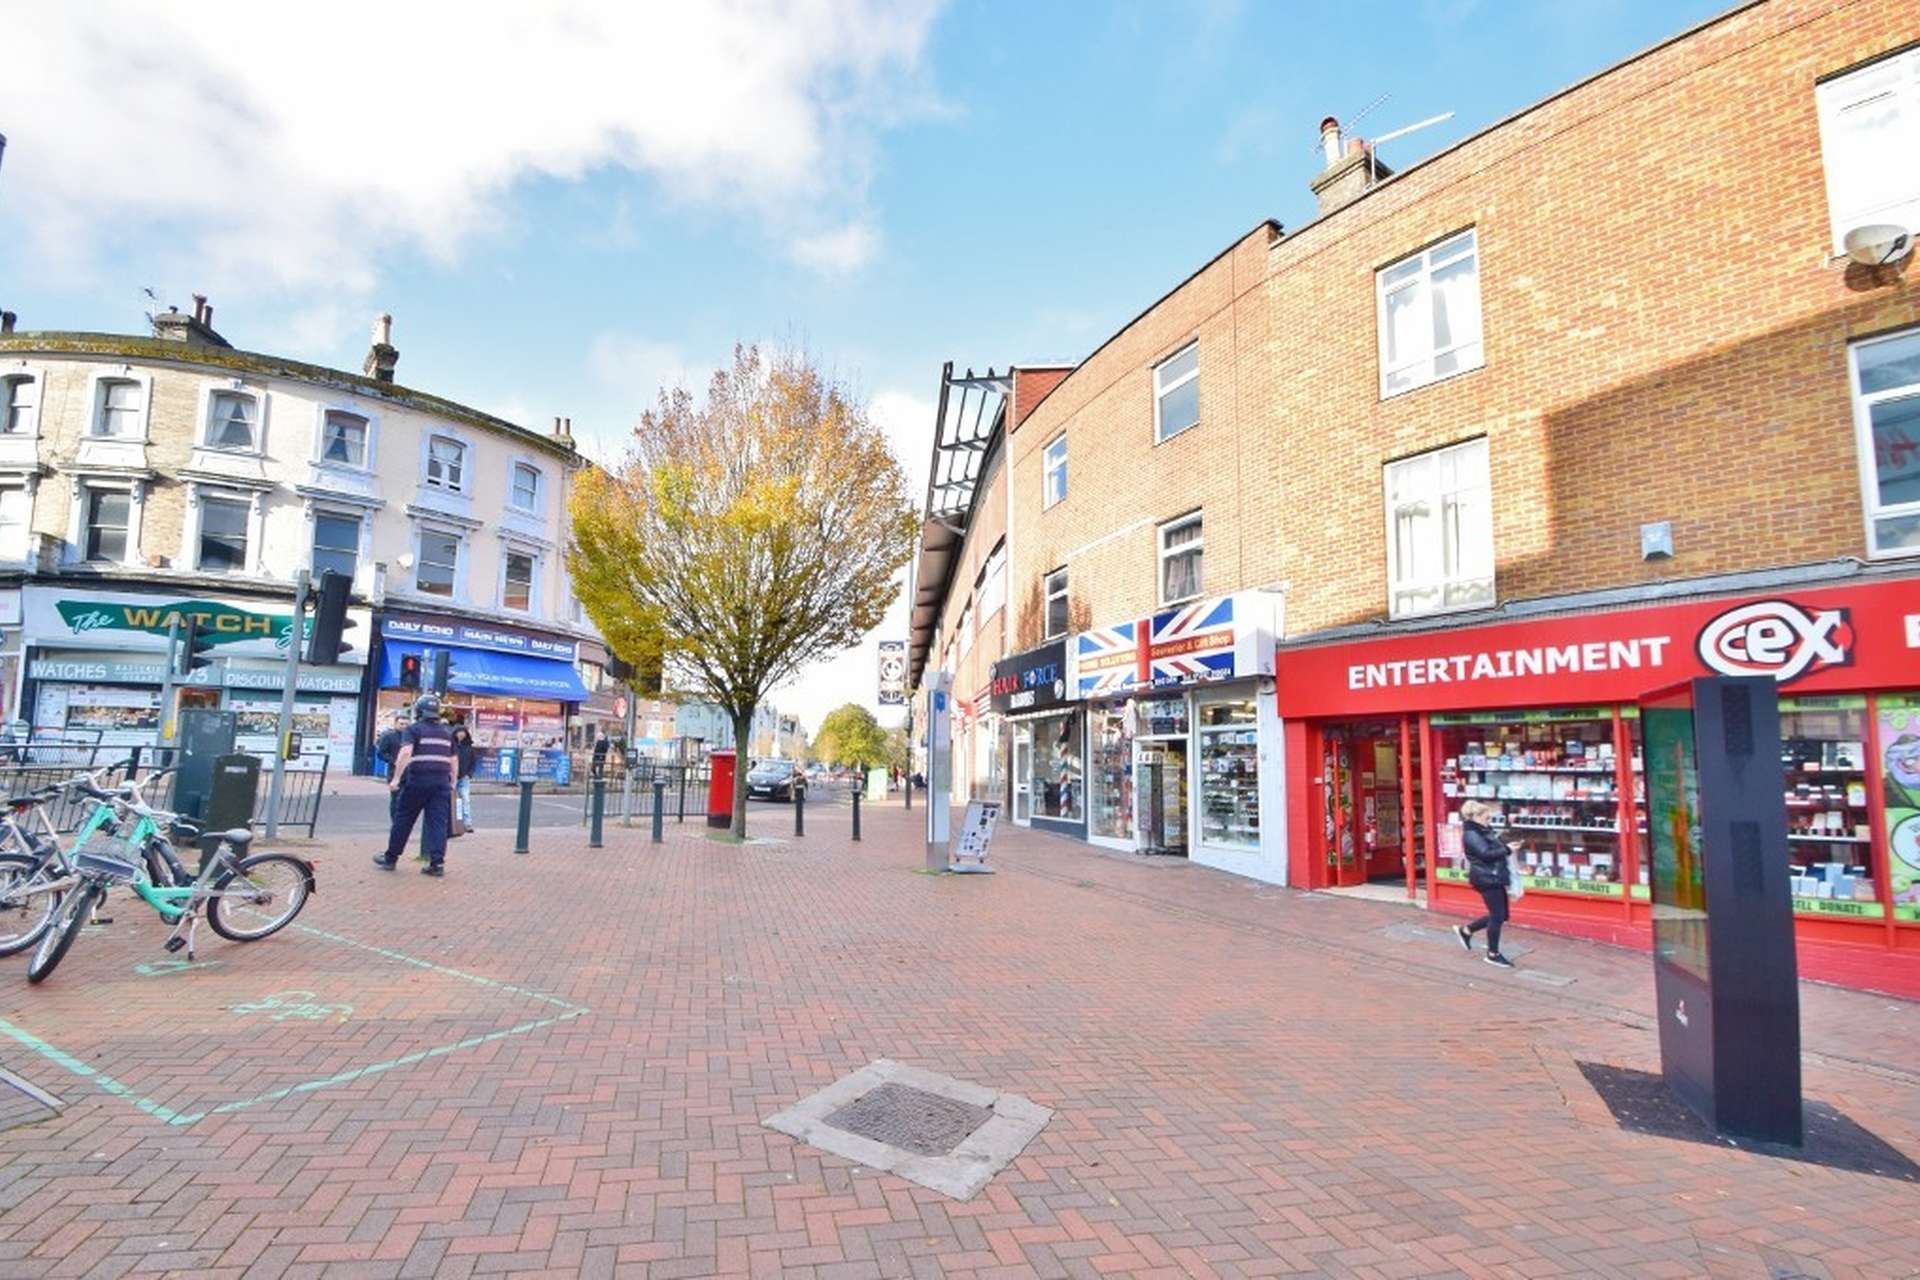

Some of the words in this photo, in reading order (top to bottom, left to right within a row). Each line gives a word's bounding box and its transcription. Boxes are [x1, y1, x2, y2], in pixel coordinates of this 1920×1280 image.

[72, 610, 116, 635] The
[123, 607, 271, 634] WATCH
[388, 620, 420, 632] DAILY
[31, 661, 107, 680] WATCHES
[1347, 636, 1672, 690] ENTERTAINMENT
[295, 676, 356, 690] WATCHES
